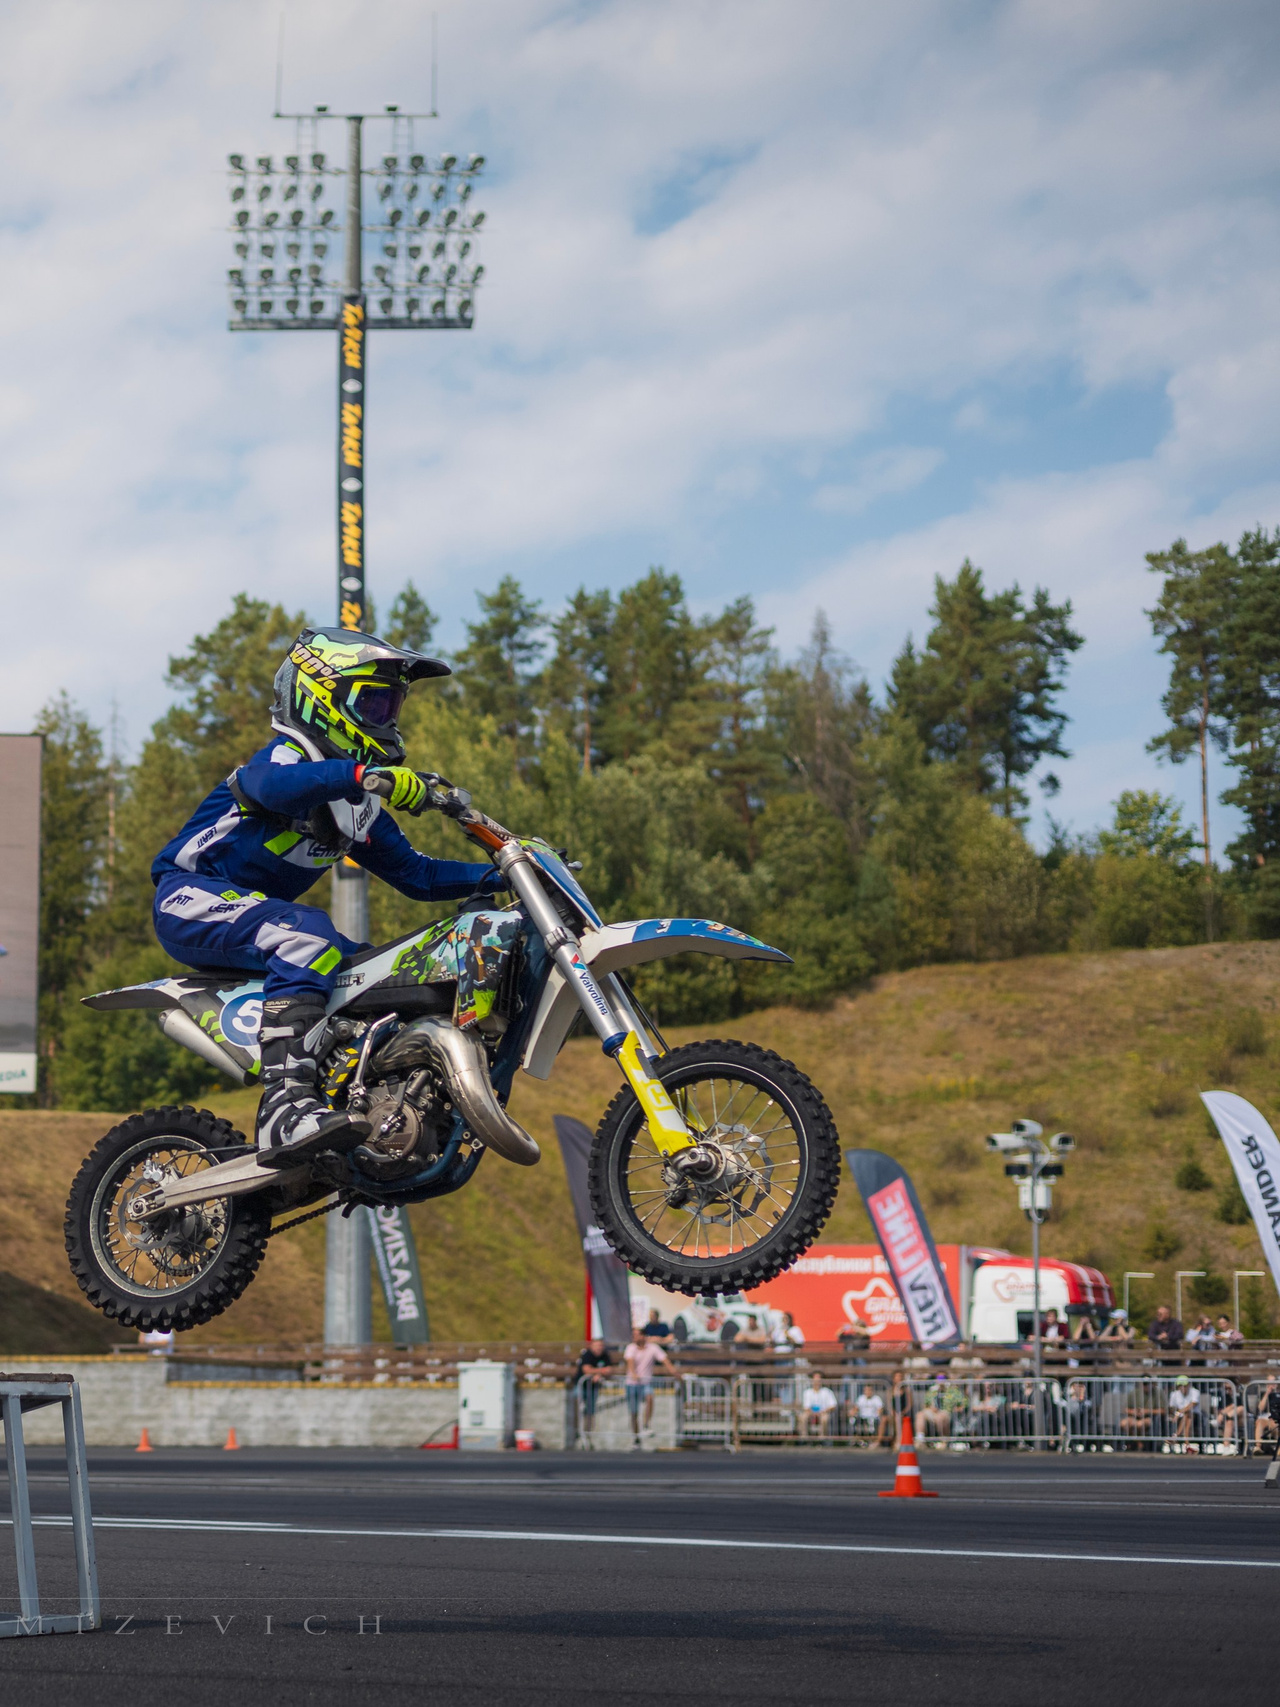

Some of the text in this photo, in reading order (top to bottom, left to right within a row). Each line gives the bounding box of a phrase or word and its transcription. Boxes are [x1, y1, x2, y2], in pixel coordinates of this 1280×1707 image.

[289, 642, 342, 690] 100%
[580, 972, 608, 1015] Valvoline
[231, 999, 263, 1034] 5
